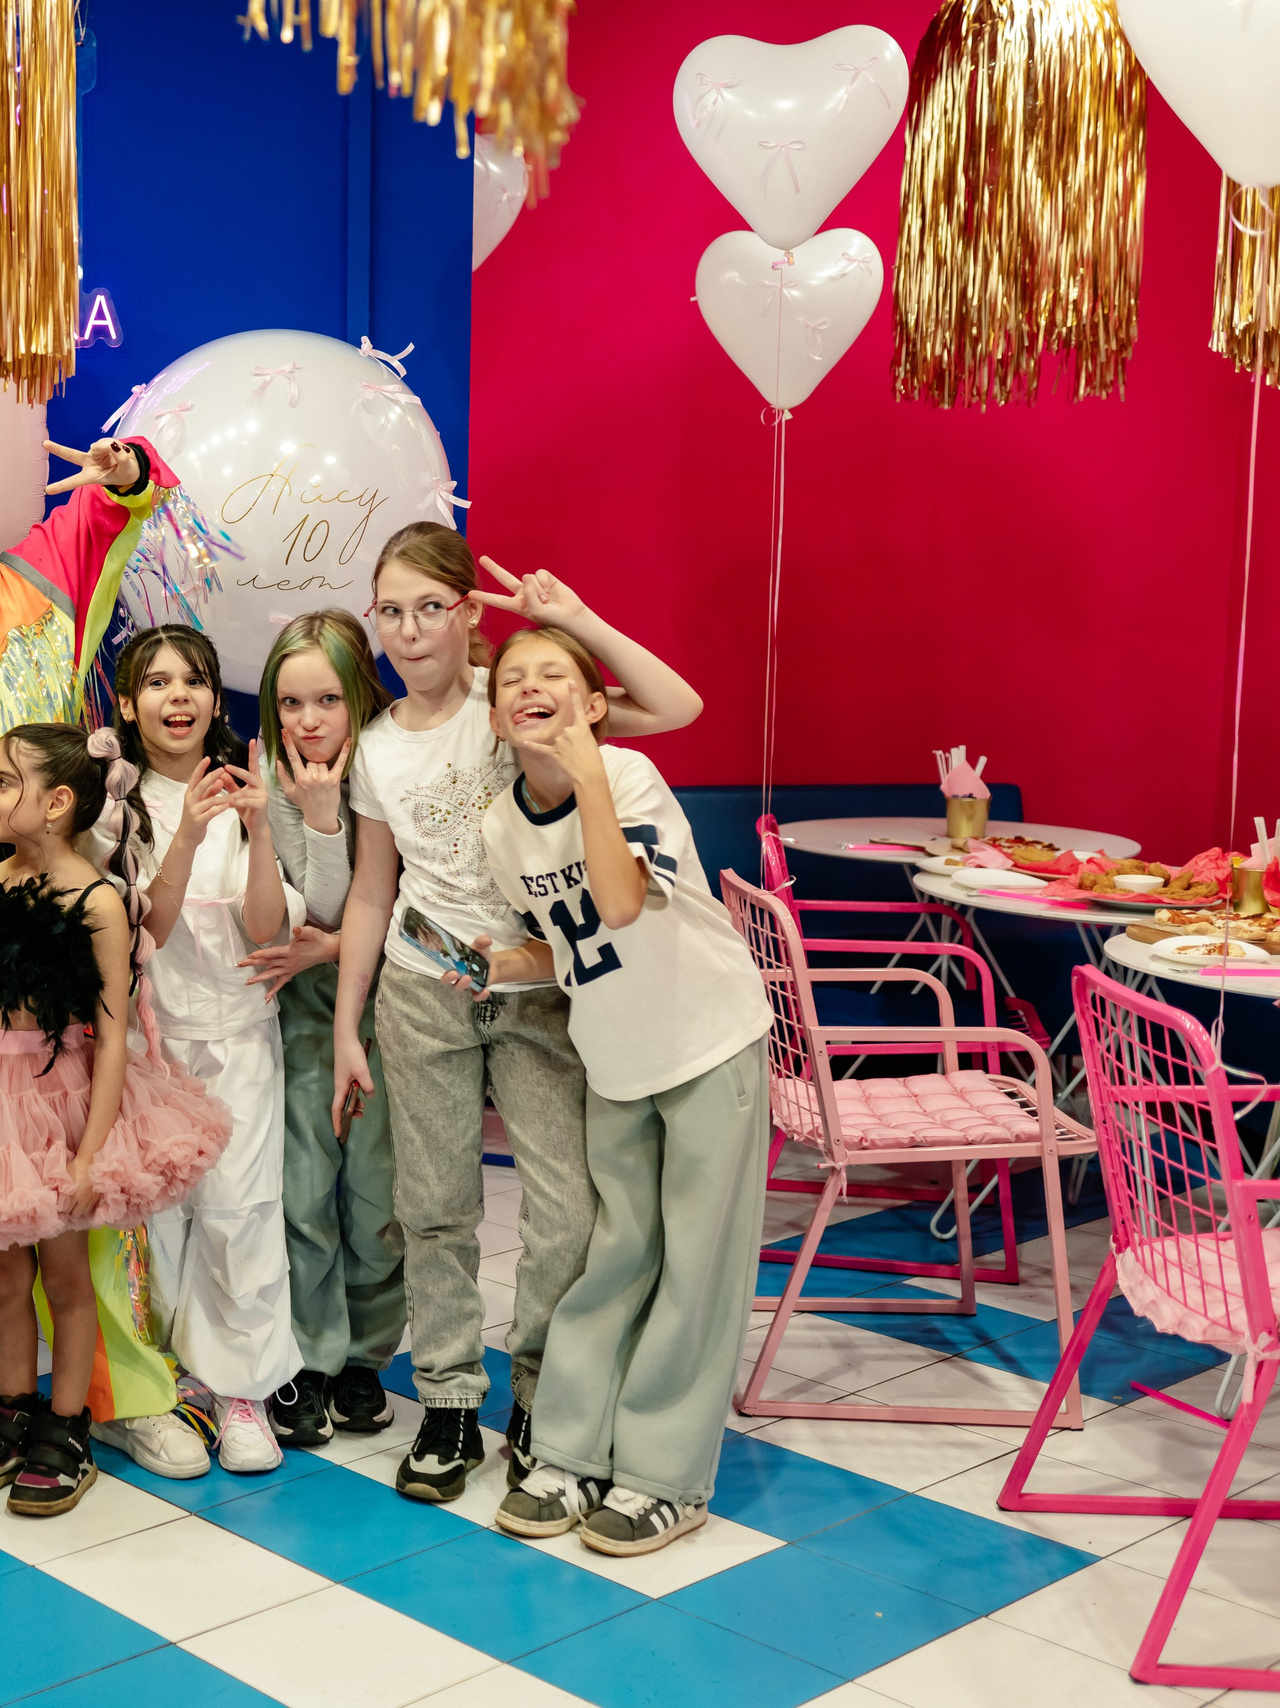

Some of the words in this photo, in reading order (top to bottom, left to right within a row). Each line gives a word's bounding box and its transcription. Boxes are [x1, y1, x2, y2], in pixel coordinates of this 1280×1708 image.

[282, 514, 330, 566] 10
[236, 573, 354, 591] лет
[549, 887, 623, 986] 12
